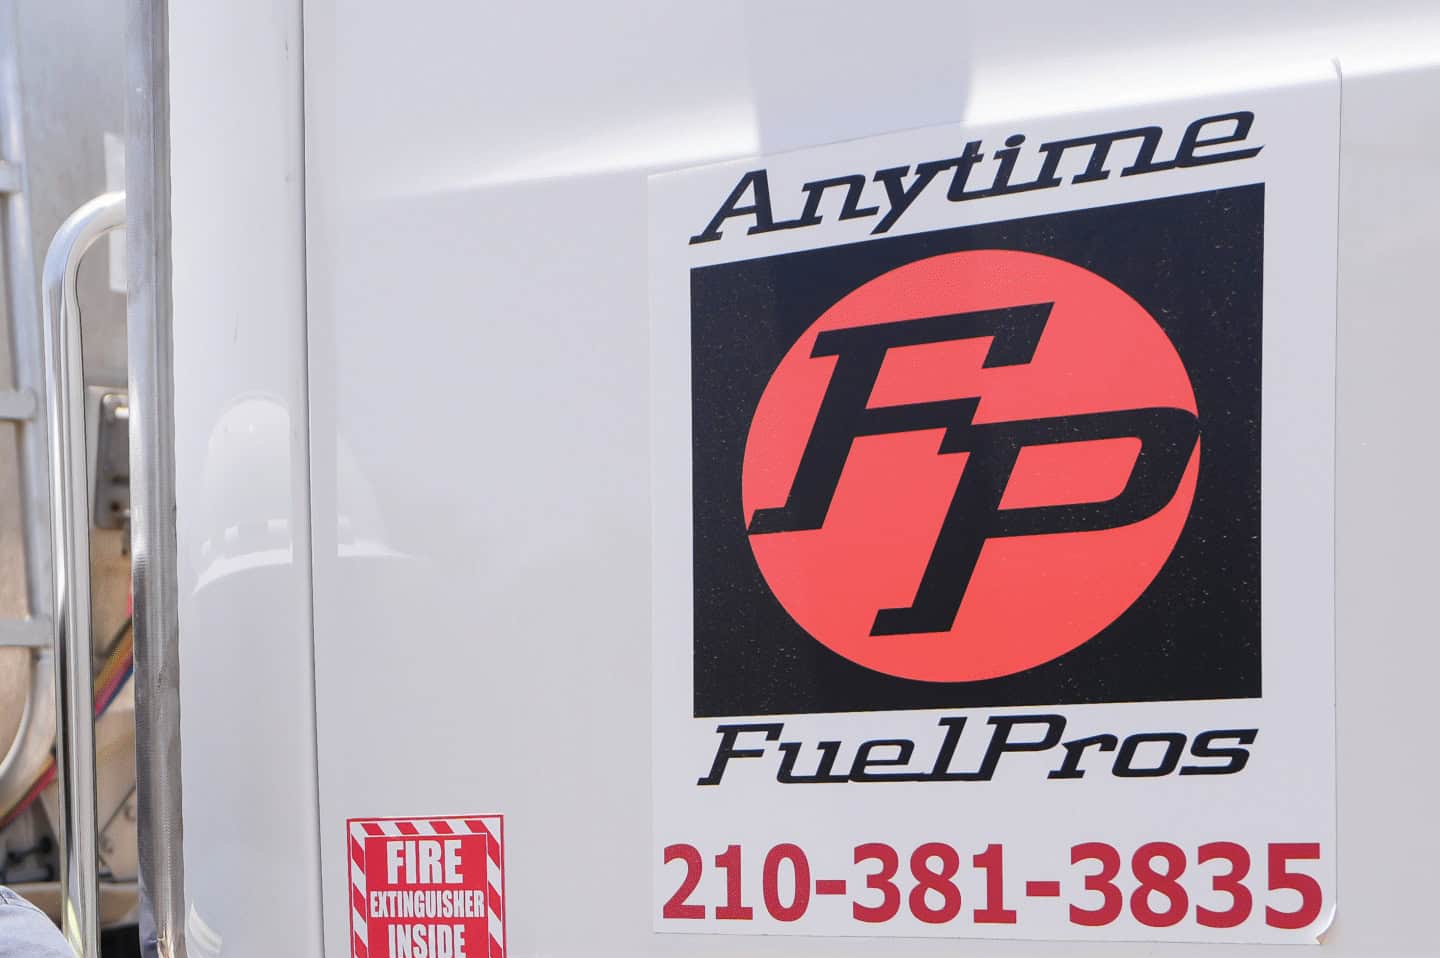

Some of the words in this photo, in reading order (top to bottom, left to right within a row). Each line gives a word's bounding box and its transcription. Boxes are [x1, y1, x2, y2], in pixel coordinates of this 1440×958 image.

[688, 110, 1265, 245] Anytime
[746, 301, 1202, 637] FP
[696, 713, 1260, 786] FuelPros
[386, 839, 464, 885] FIRE
[662, 840, 1323, 930] 210-381-3835
[369, 889, 485, 918] EXTINGUISHER
